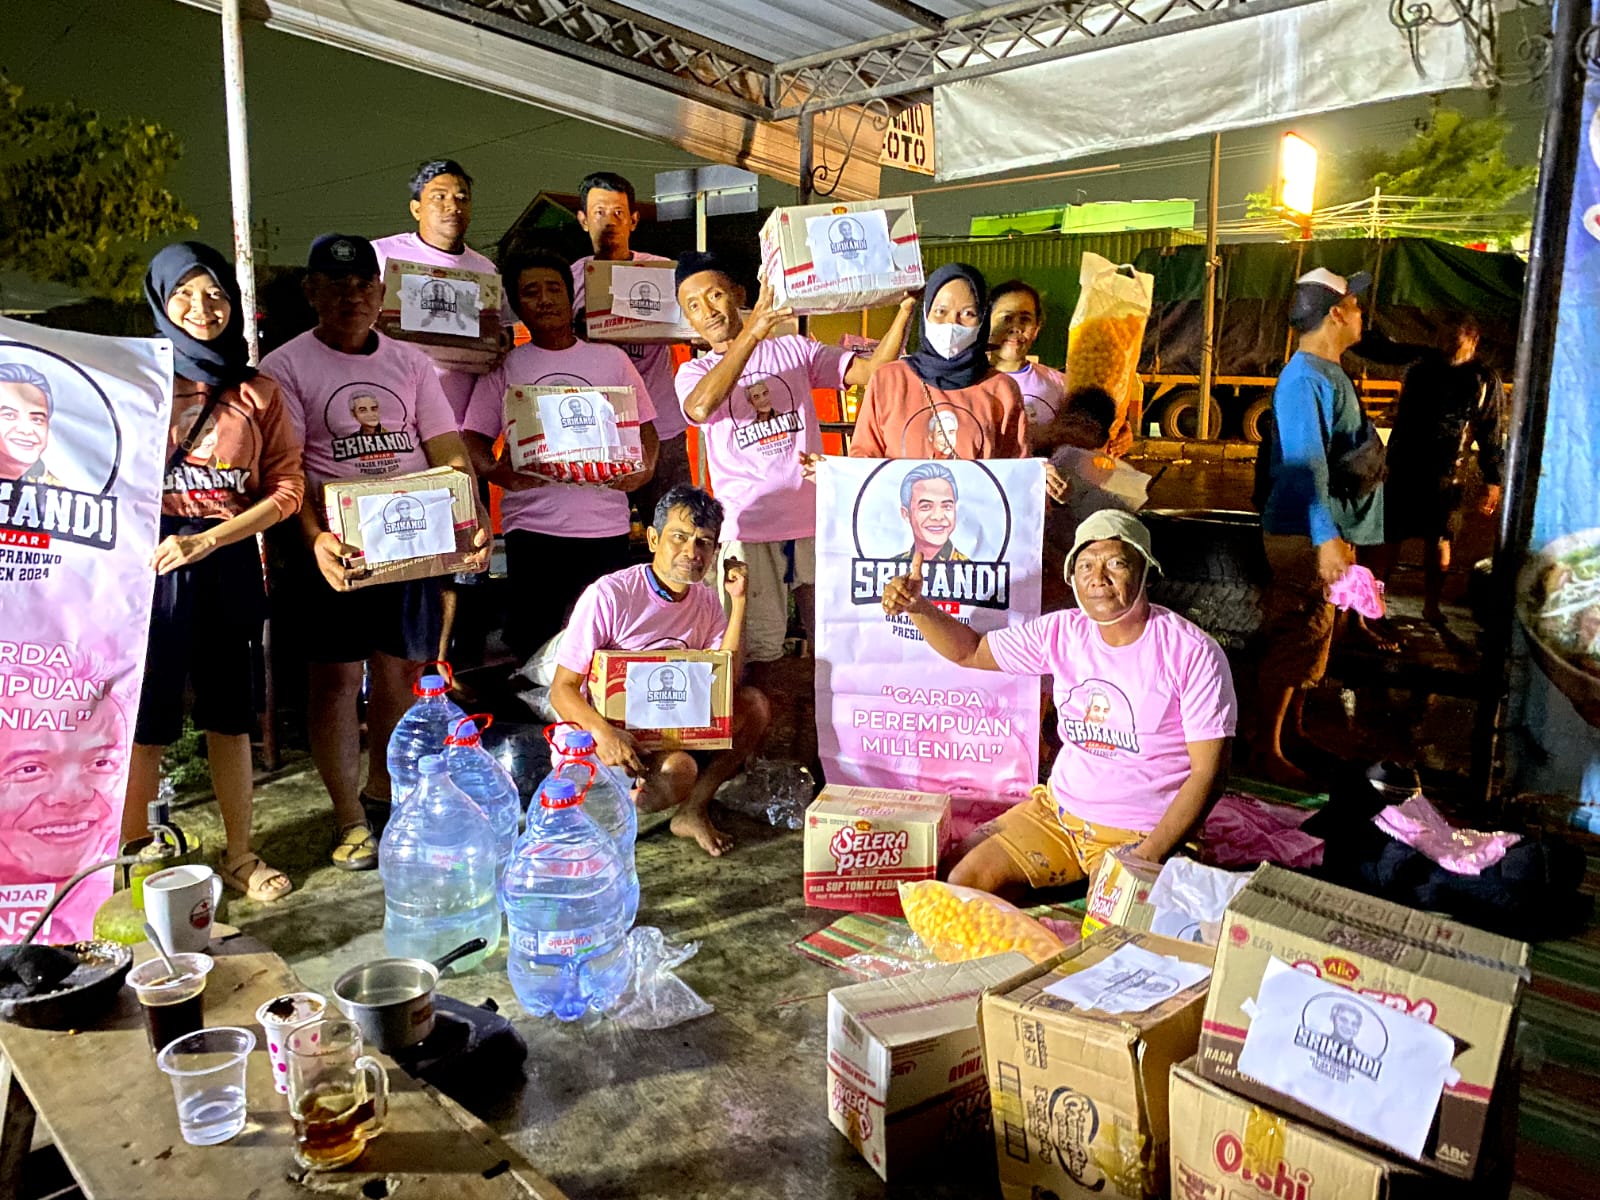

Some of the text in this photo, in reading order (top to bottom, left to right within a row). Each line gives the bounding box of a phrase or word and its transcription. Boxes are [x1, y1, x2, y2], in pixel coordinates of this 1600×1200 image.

[882, 131, 926, 166] OTO
[561, 416, 597, 428] SRIKANDI
[735, 412, 804, 448] SRIKANDI
[332, 432, 413, 461] SRIKANDI
[384, 519, 426, 534] SRIKANDI
[19, 567, 49, 581] 2024
[647, 690, 687, 702] SRIKANDI
[882, 685, 984, 709] “GARDA
[852, 710, 1013, 738] PEREMPUAN
[860, 736, 1004, 764] MILLENIAL”
[826, 880, 844, 892] SUP
[845, 880, 875, 891] TOMAT
